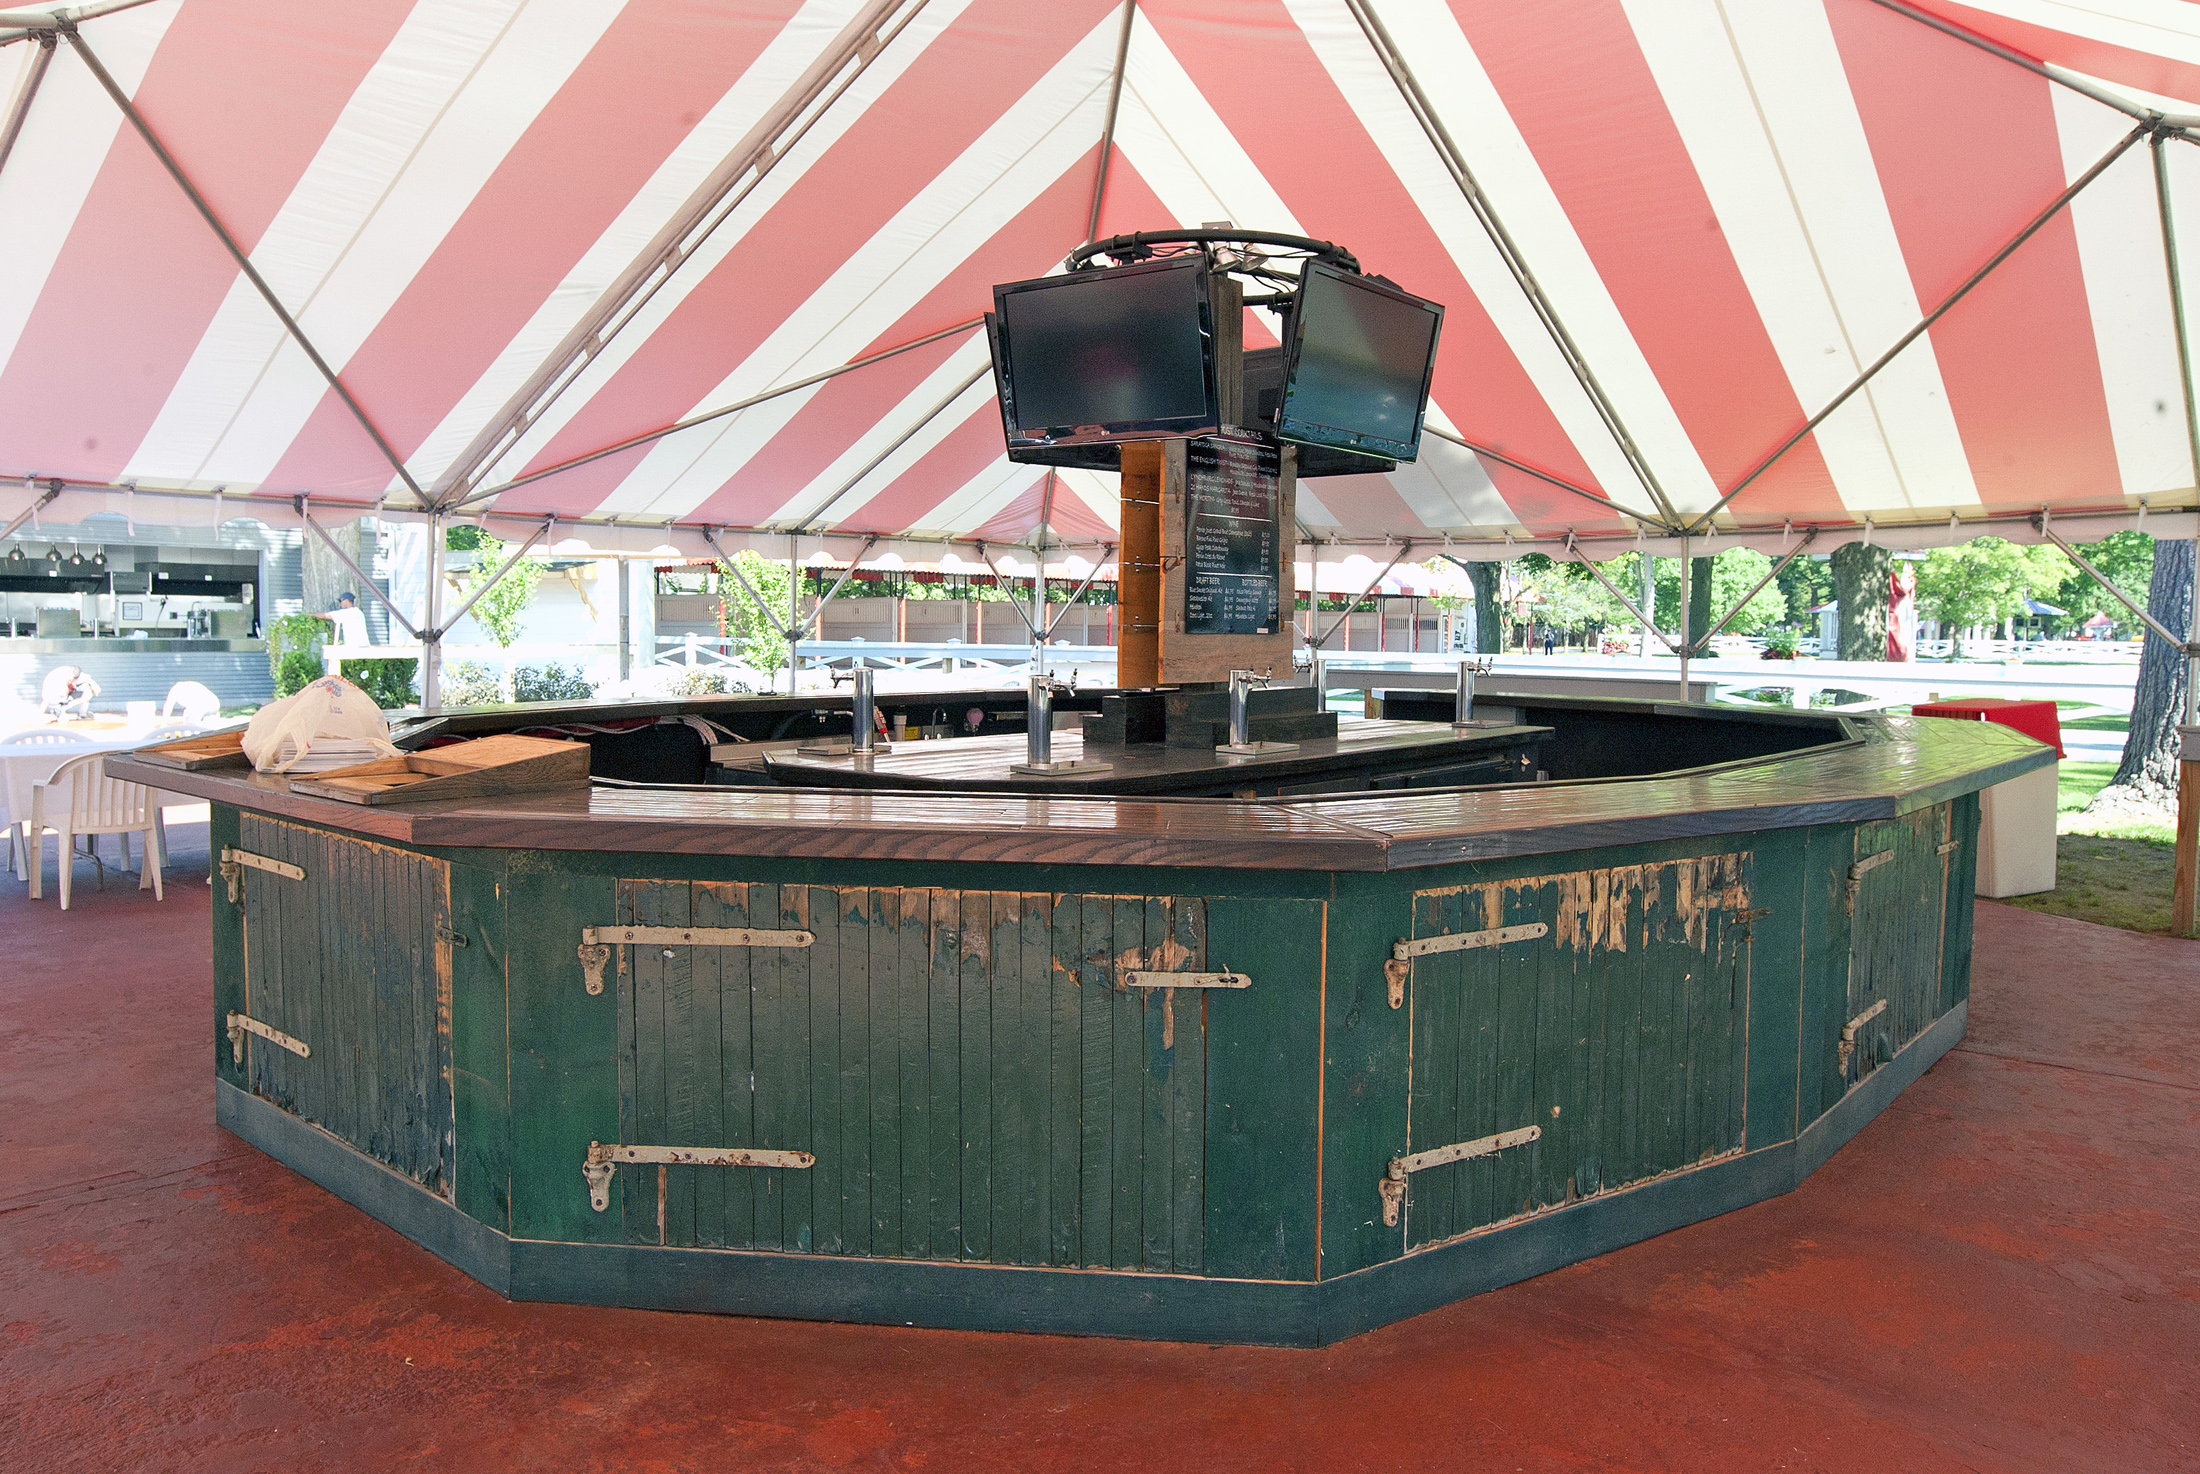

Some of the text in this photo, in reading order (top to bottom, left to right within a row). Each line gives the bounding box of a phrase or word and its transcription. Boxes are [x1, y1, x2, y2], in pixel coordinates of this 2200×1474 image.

[1191, 455, 1199, 463] THE
[1196, 576, 1221, 585] DRAFT BEER
